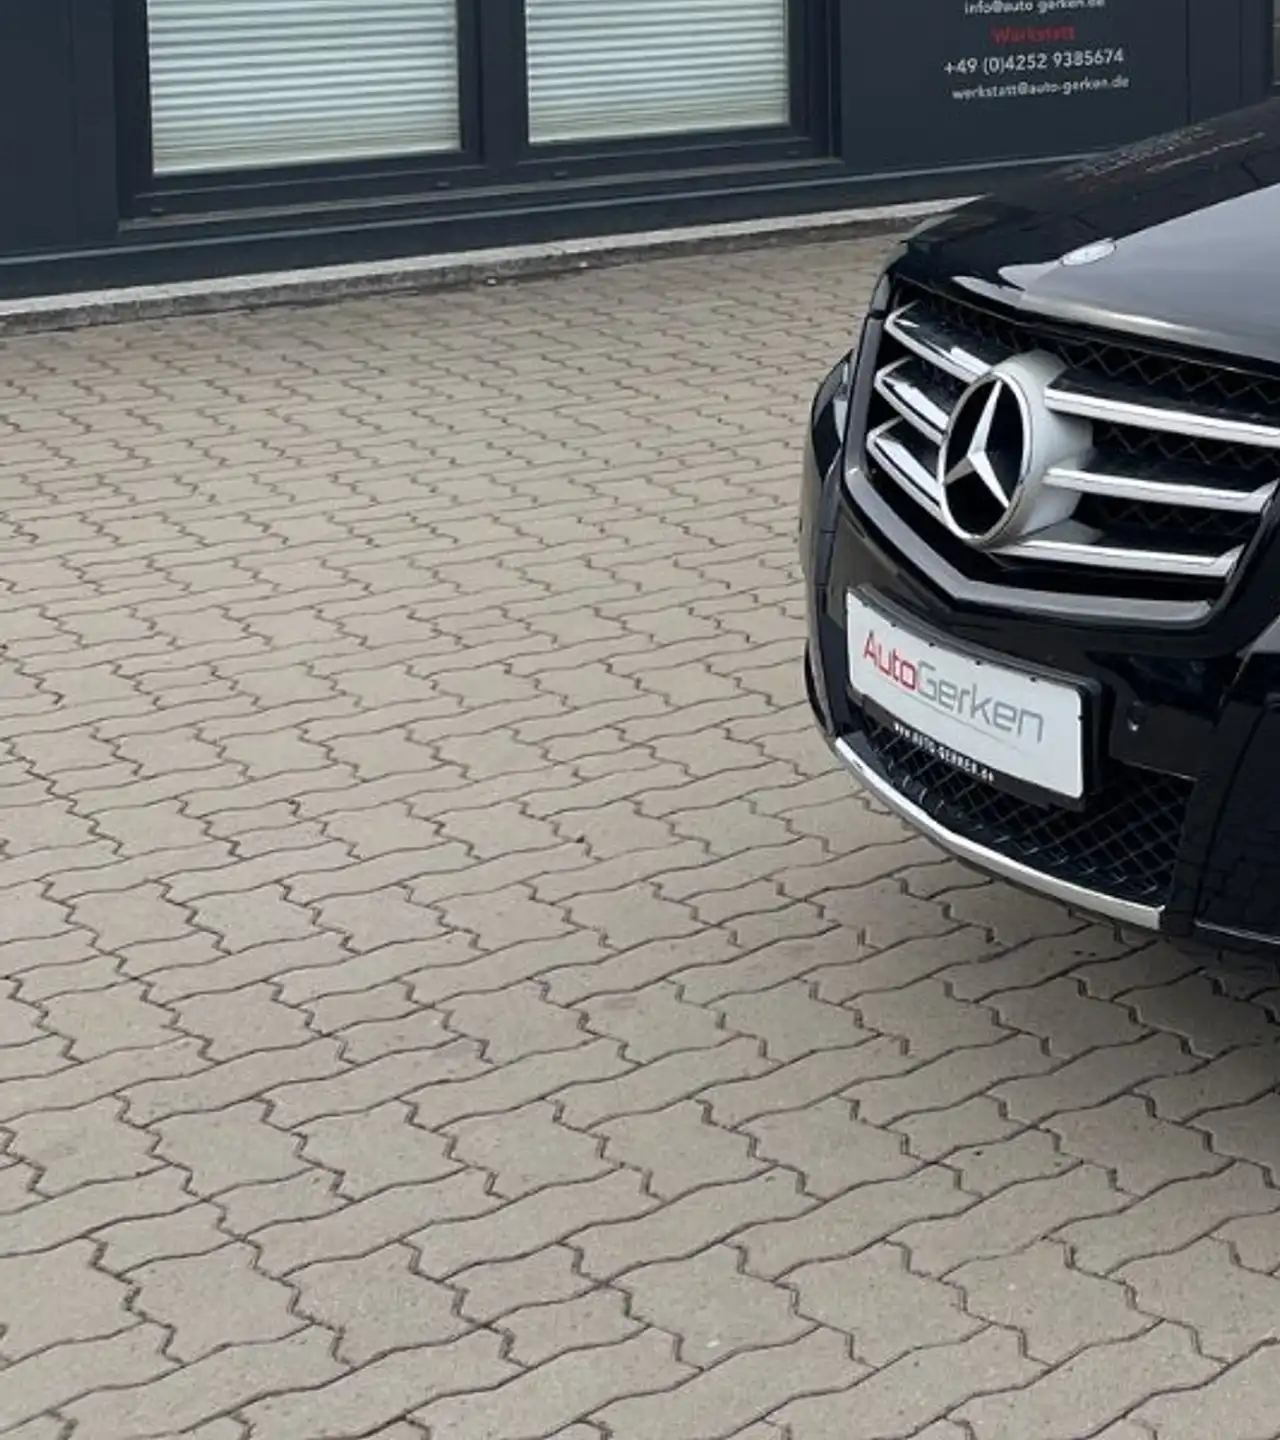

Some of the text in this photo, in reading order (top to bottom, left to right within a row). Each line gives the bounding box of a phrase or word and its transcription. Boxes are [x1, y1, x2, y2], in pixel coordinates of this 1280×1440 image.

[944, 57, 978, 75] +49
[983, 53, 1047, 75] (0)4252
[862, 630, 1045, 744] AutoGerken
